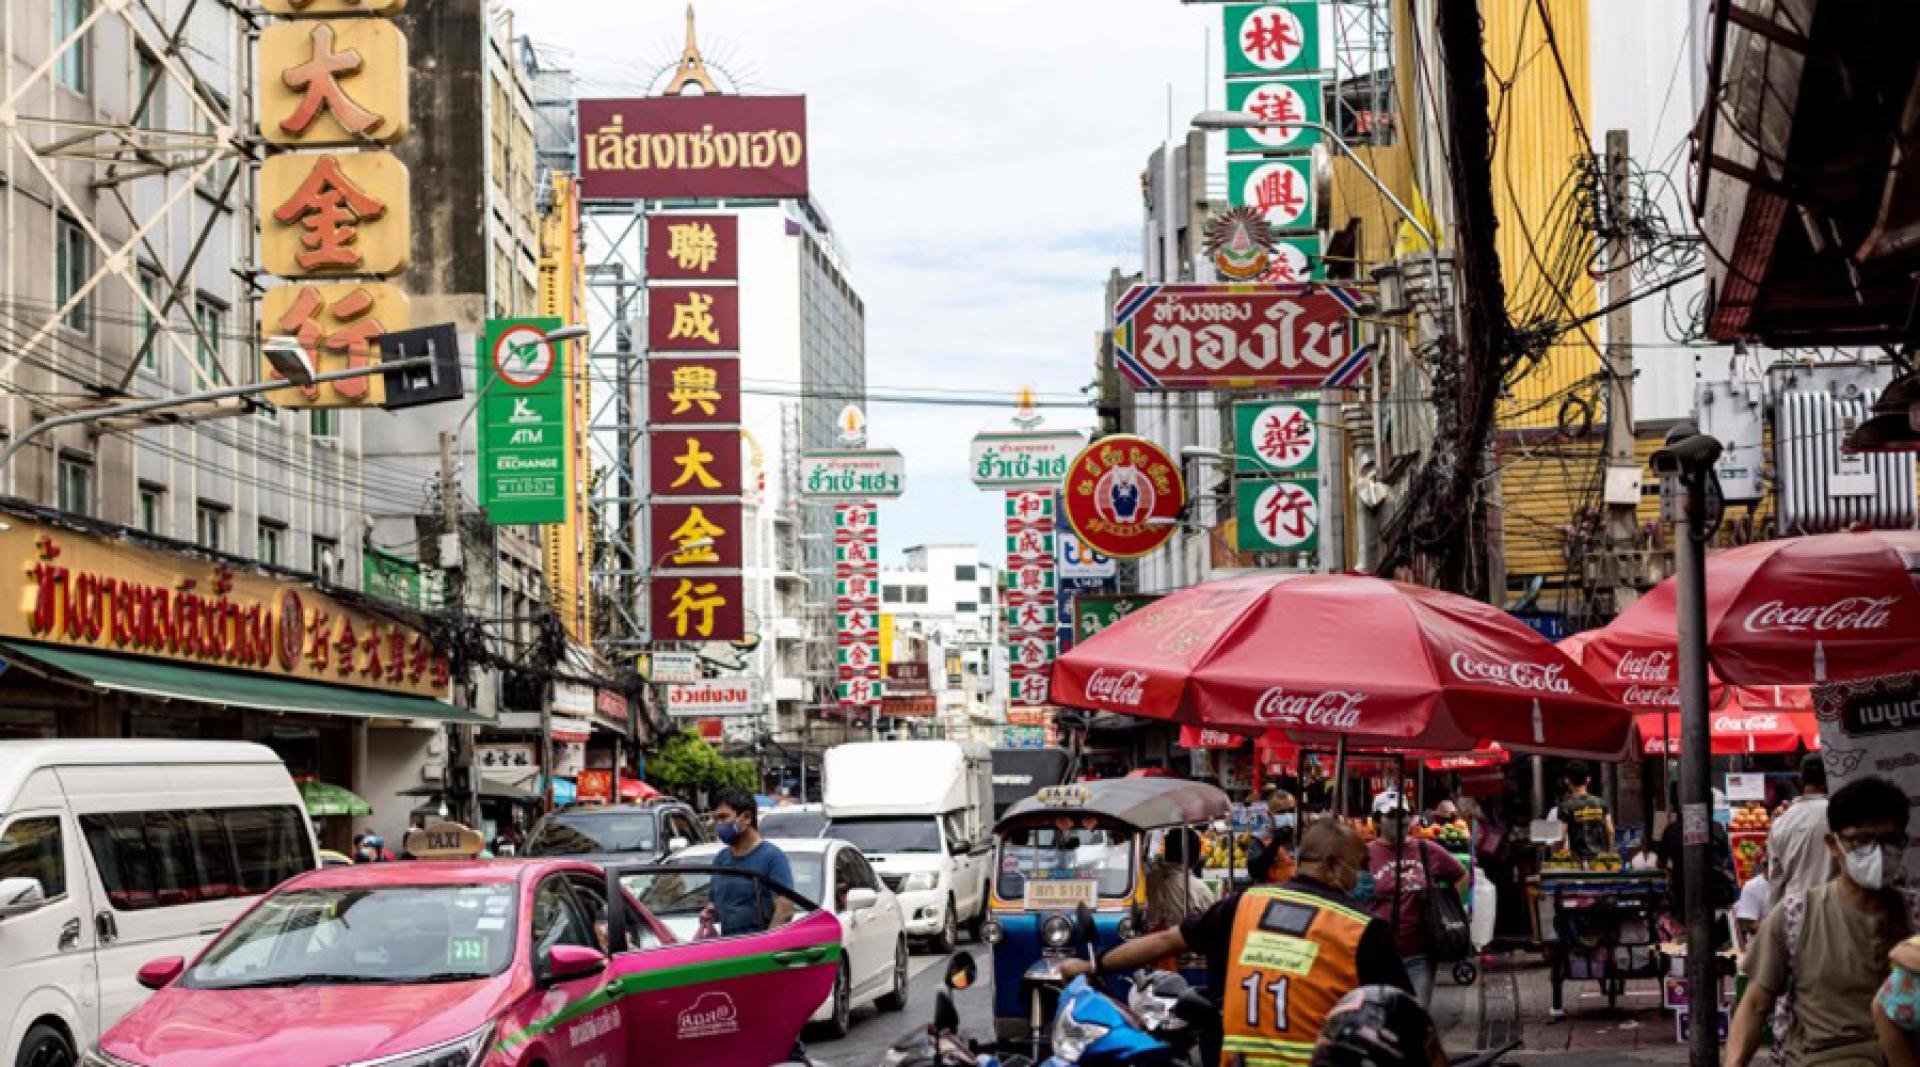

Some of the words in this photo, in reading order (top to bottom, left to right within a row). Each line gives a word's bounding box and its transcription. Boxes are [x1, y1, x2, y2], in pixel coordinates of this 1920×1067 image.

[584, 114, 802, 169] เลี่ยงเซ่งเฮง
[275, 0, 387, 399] 大金行
[1141, 300, 1346, 370] ทองใบ
[510, 429, 542, 445] ATM
[497, 458, 559, 471] EXCHANGE
[977, 447, 1067, 478] ฮั่วเซ่งเฮ
[1744, 596, 1902, 632] Coca-Cola
[1450, 652, 1573, 694] Coca-Cola
[1254, 686, 1369, 728] Coca-Cola
[426, 832, 462, 849] TAXI
[1241, 970, 1290, 1032] 11
